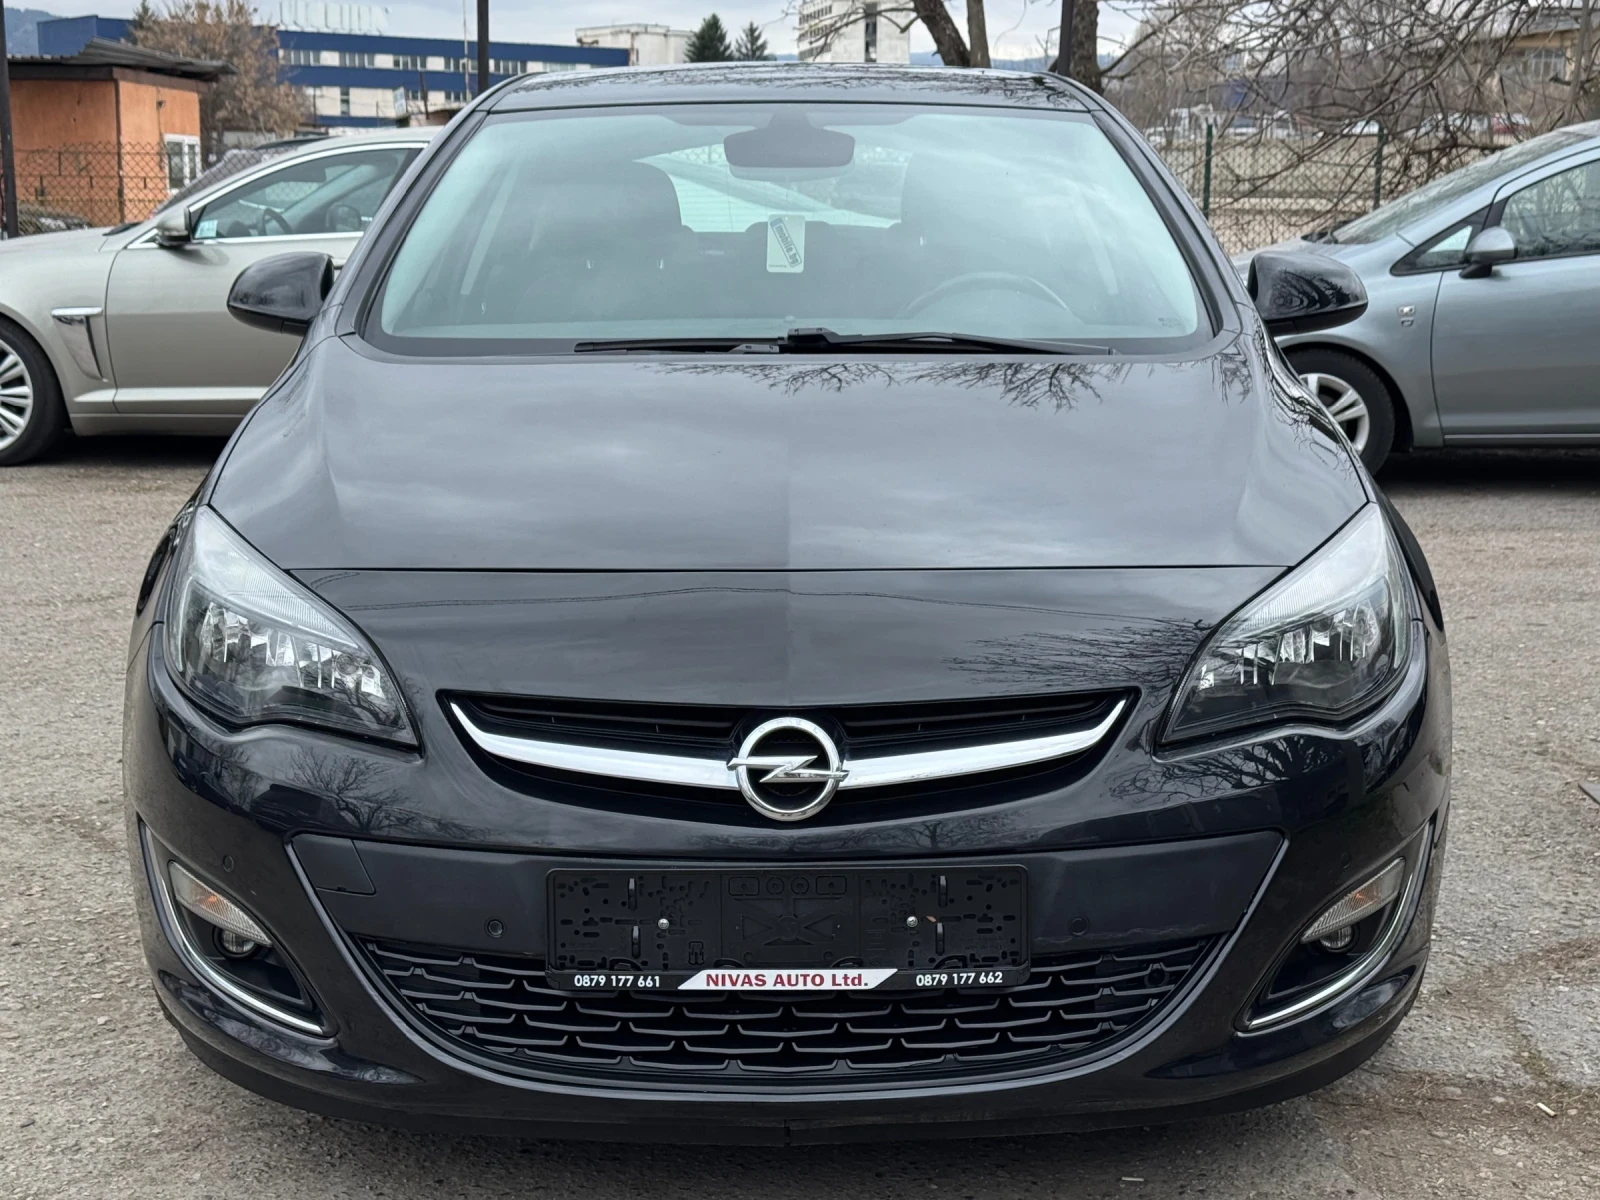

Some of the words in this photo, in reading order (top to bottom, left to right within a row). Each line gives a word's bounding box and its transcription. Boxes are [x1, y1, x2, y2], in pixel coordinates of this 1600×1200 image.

[775, 224, 799, 265] mobile.bg
[574, 974, 606, 987] 0879
[611, 975, 634, 987] 177
[637, 975, 660, 988] 661
[705, 973, 767, 987] NIVAS
[773, 973, 825, 987] AUTO
[831, 973, 869, 987] Ltd.
[916, 973, 948, 987] 0879
[952, 972, 976, 985] 177
[979, 971, 1003, 984] 662
